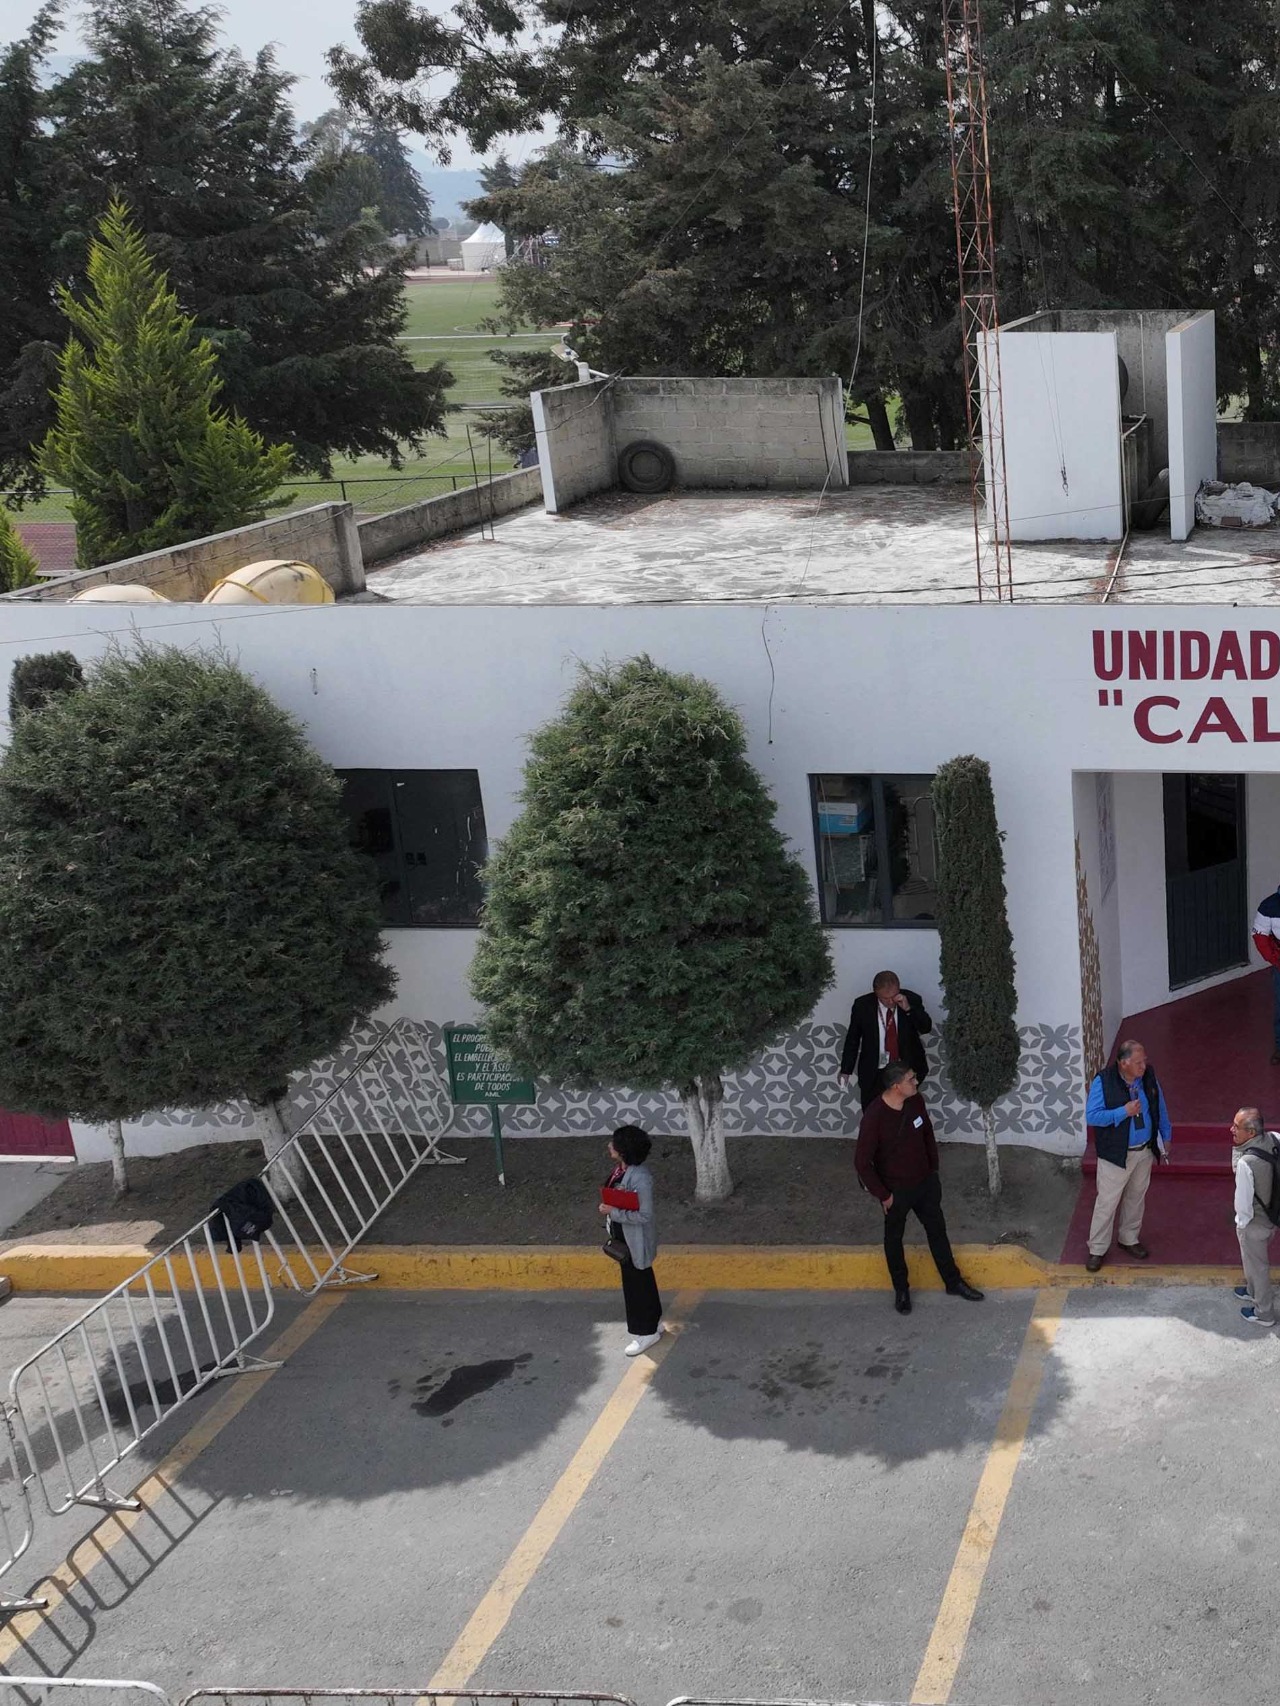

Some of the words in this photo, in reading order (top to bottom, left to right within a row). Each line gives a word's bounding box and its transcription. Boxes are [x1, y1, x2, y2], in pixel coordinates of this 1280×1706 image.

[1092, 629, 1280, 681] UNIDAD
[453, 1034, 460, 1043] EL
[454, 1053, 462, 1062] EL
[464, 1053, 498, 1062] EMBELLEC
[475, 1063, 481, 1072] Y
[482, 1062, 490, 1072] EL
[492, 1062, 511, 1072] ASEO
[456, 1072, 465, 1081] ES
[474, 1082, 485, 1091] DE
[487, 1082, 511, 1091] TODOS
